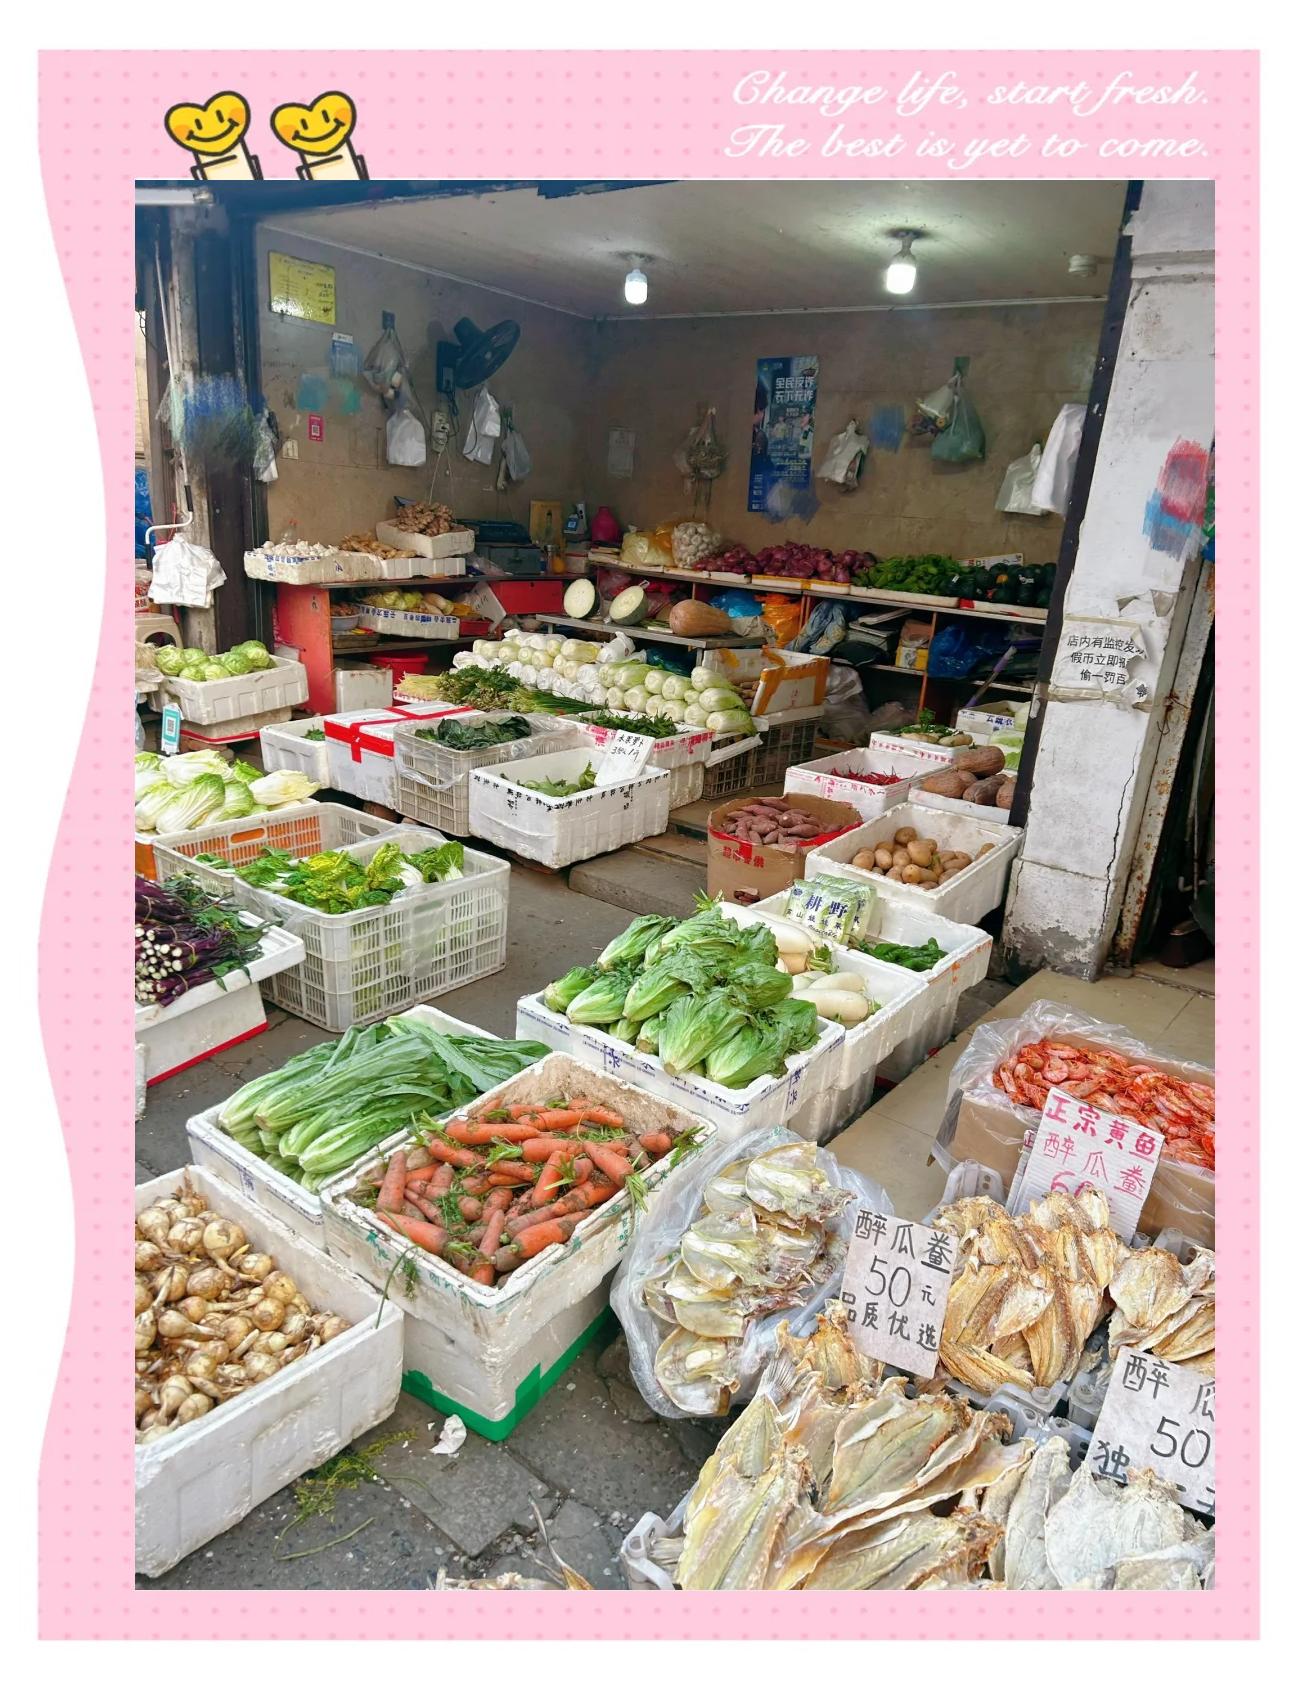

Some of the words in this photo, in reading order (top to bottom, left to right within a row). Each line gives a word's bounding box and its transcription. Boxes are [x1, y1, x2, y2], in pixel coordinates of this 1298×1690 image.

[775, 376, 815, 389] 全民反诈
[1080, 668, 1127, 686] 偷一罚百
[805, 894, 848, 918] 耕野
[1045, 1093, 1157, 1163] 正宗黄鱼
[842, 1291, 938, 1352] 品质优选
[1150, 1416, 1211, 1468] 50
